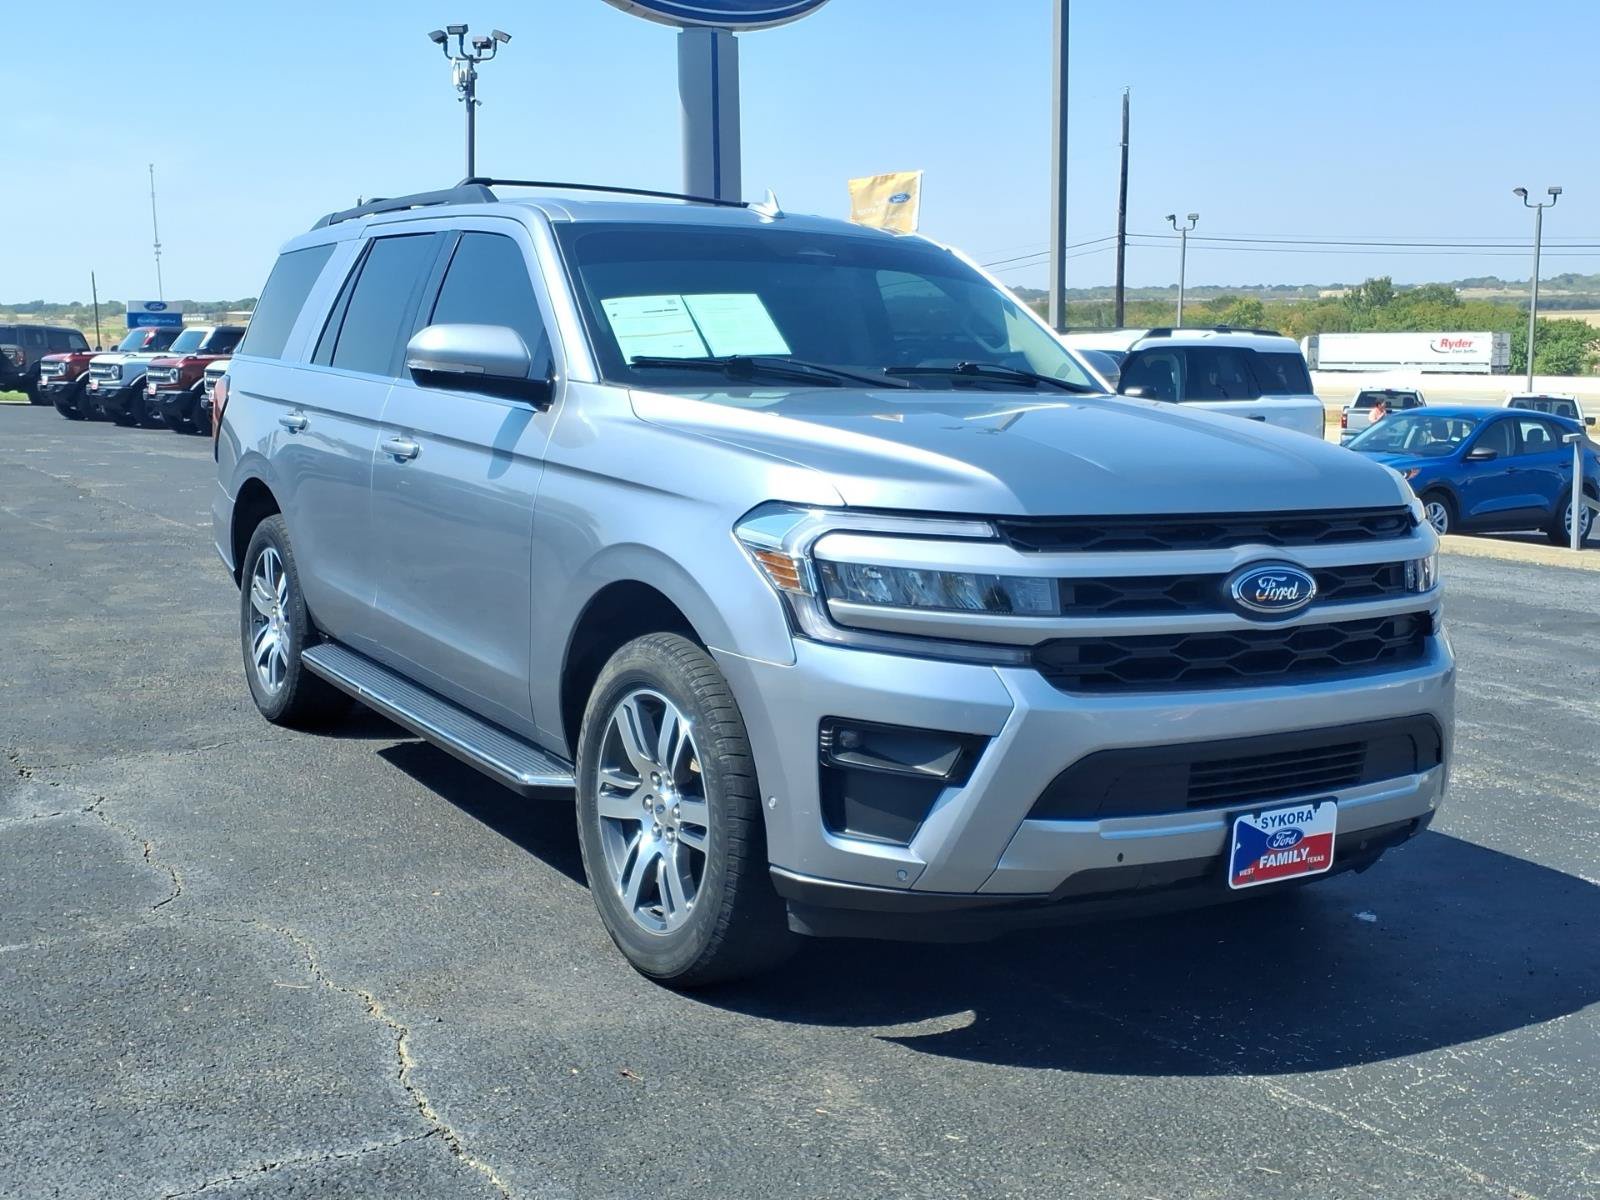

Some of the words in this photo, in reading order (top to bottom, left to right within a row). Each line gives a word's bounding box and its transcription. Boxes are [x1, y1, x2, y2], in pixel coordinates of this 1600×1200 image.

[1440, 338, 1473, 350] Ryder
[1255, 576, 1300, 602] Ford
[1261, 810, 1313, 829] SYKORA
[1272, 831, 1298, 848] Ford
[1259, 847, 1310, 869] FAMILY
[1307, 855, 1325, 864] TEXAS
[1239, 867, 1255, 877] WEST
